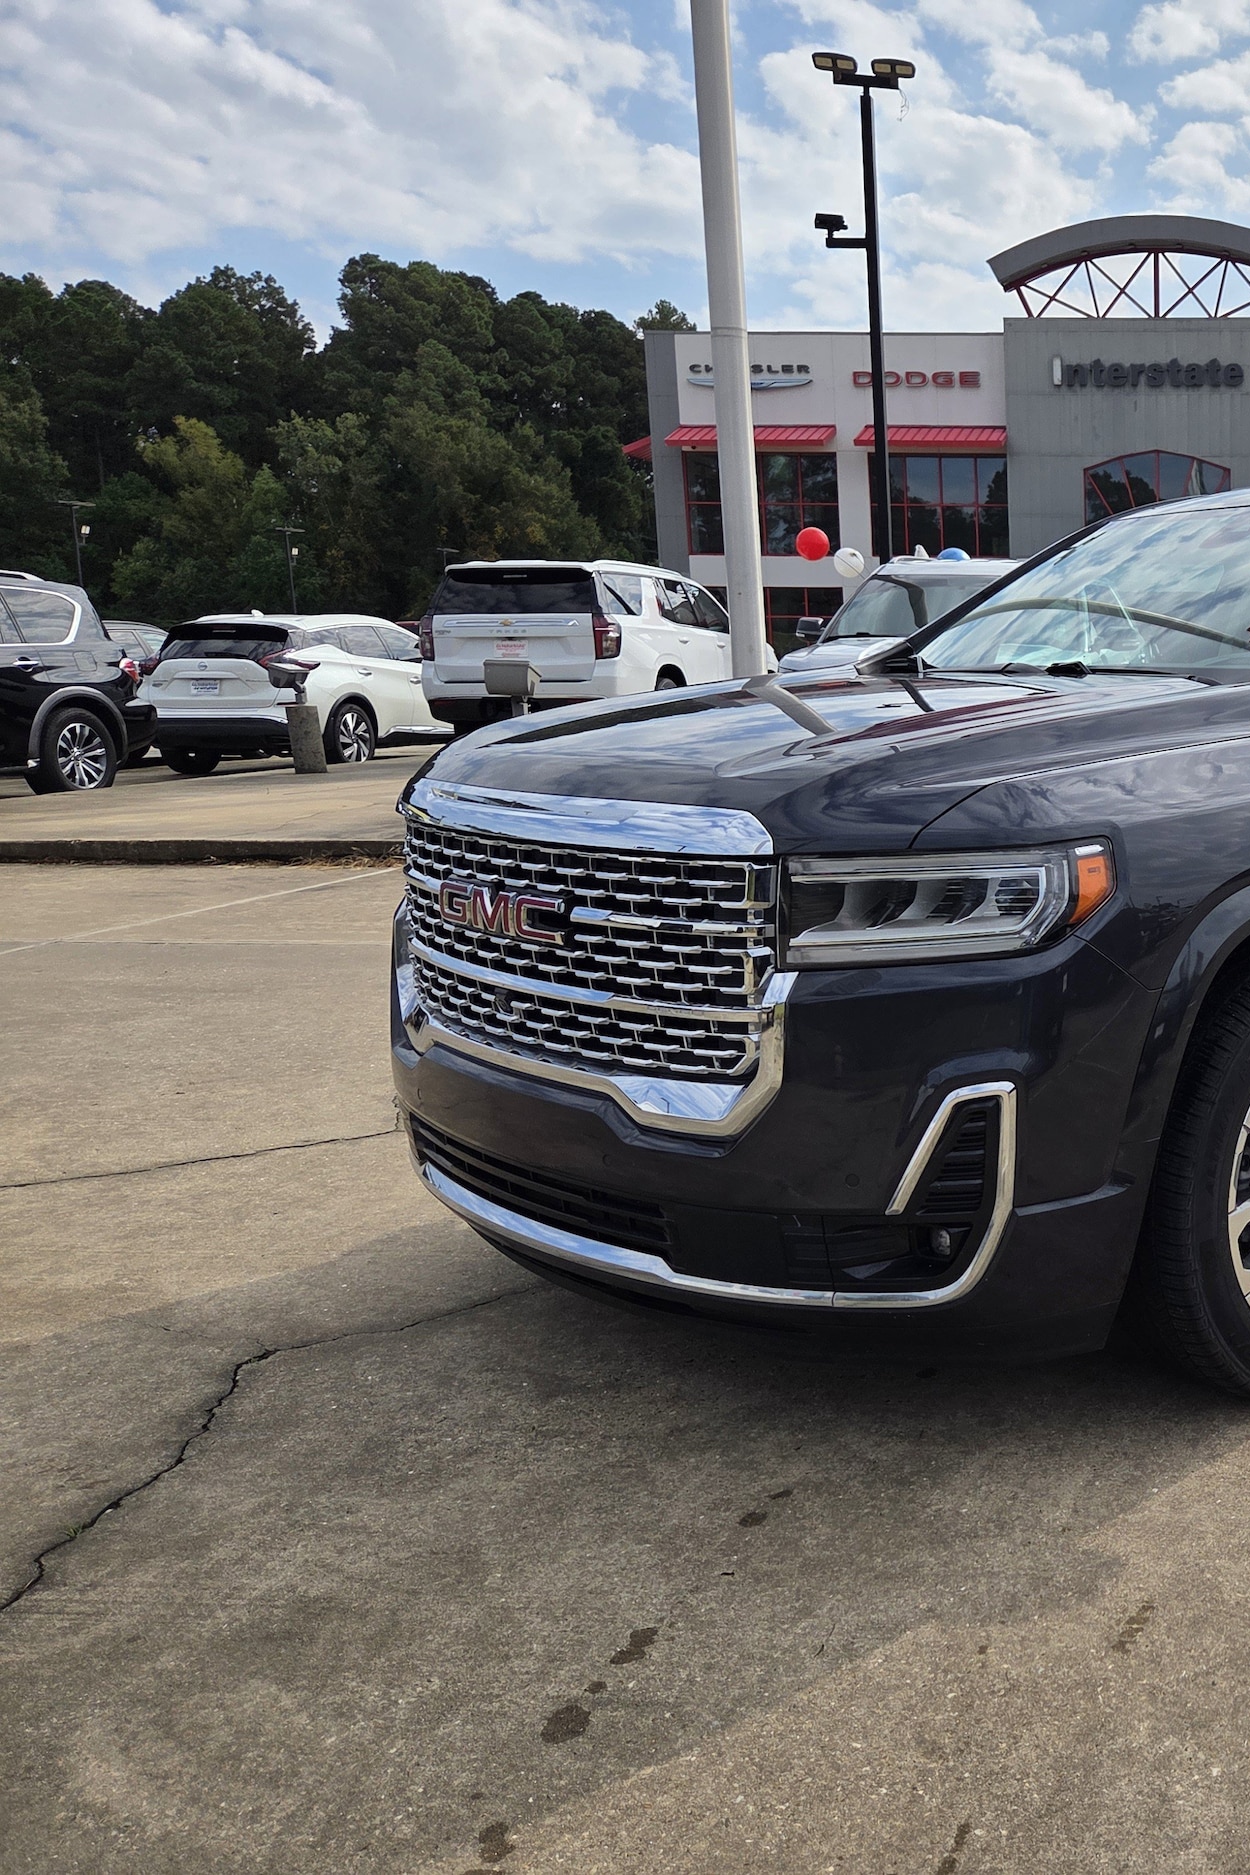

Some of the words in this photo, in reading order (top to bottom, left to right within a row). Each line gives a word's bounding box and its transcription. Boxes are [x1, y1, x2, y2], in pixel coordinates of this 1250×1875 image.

[689, 363, 811, 374] CHSLER
[852, 370, 981, 388] DODGE
[1052, 356, 1244, 387] Interstate
[440, 880, 565, 945] GMC
